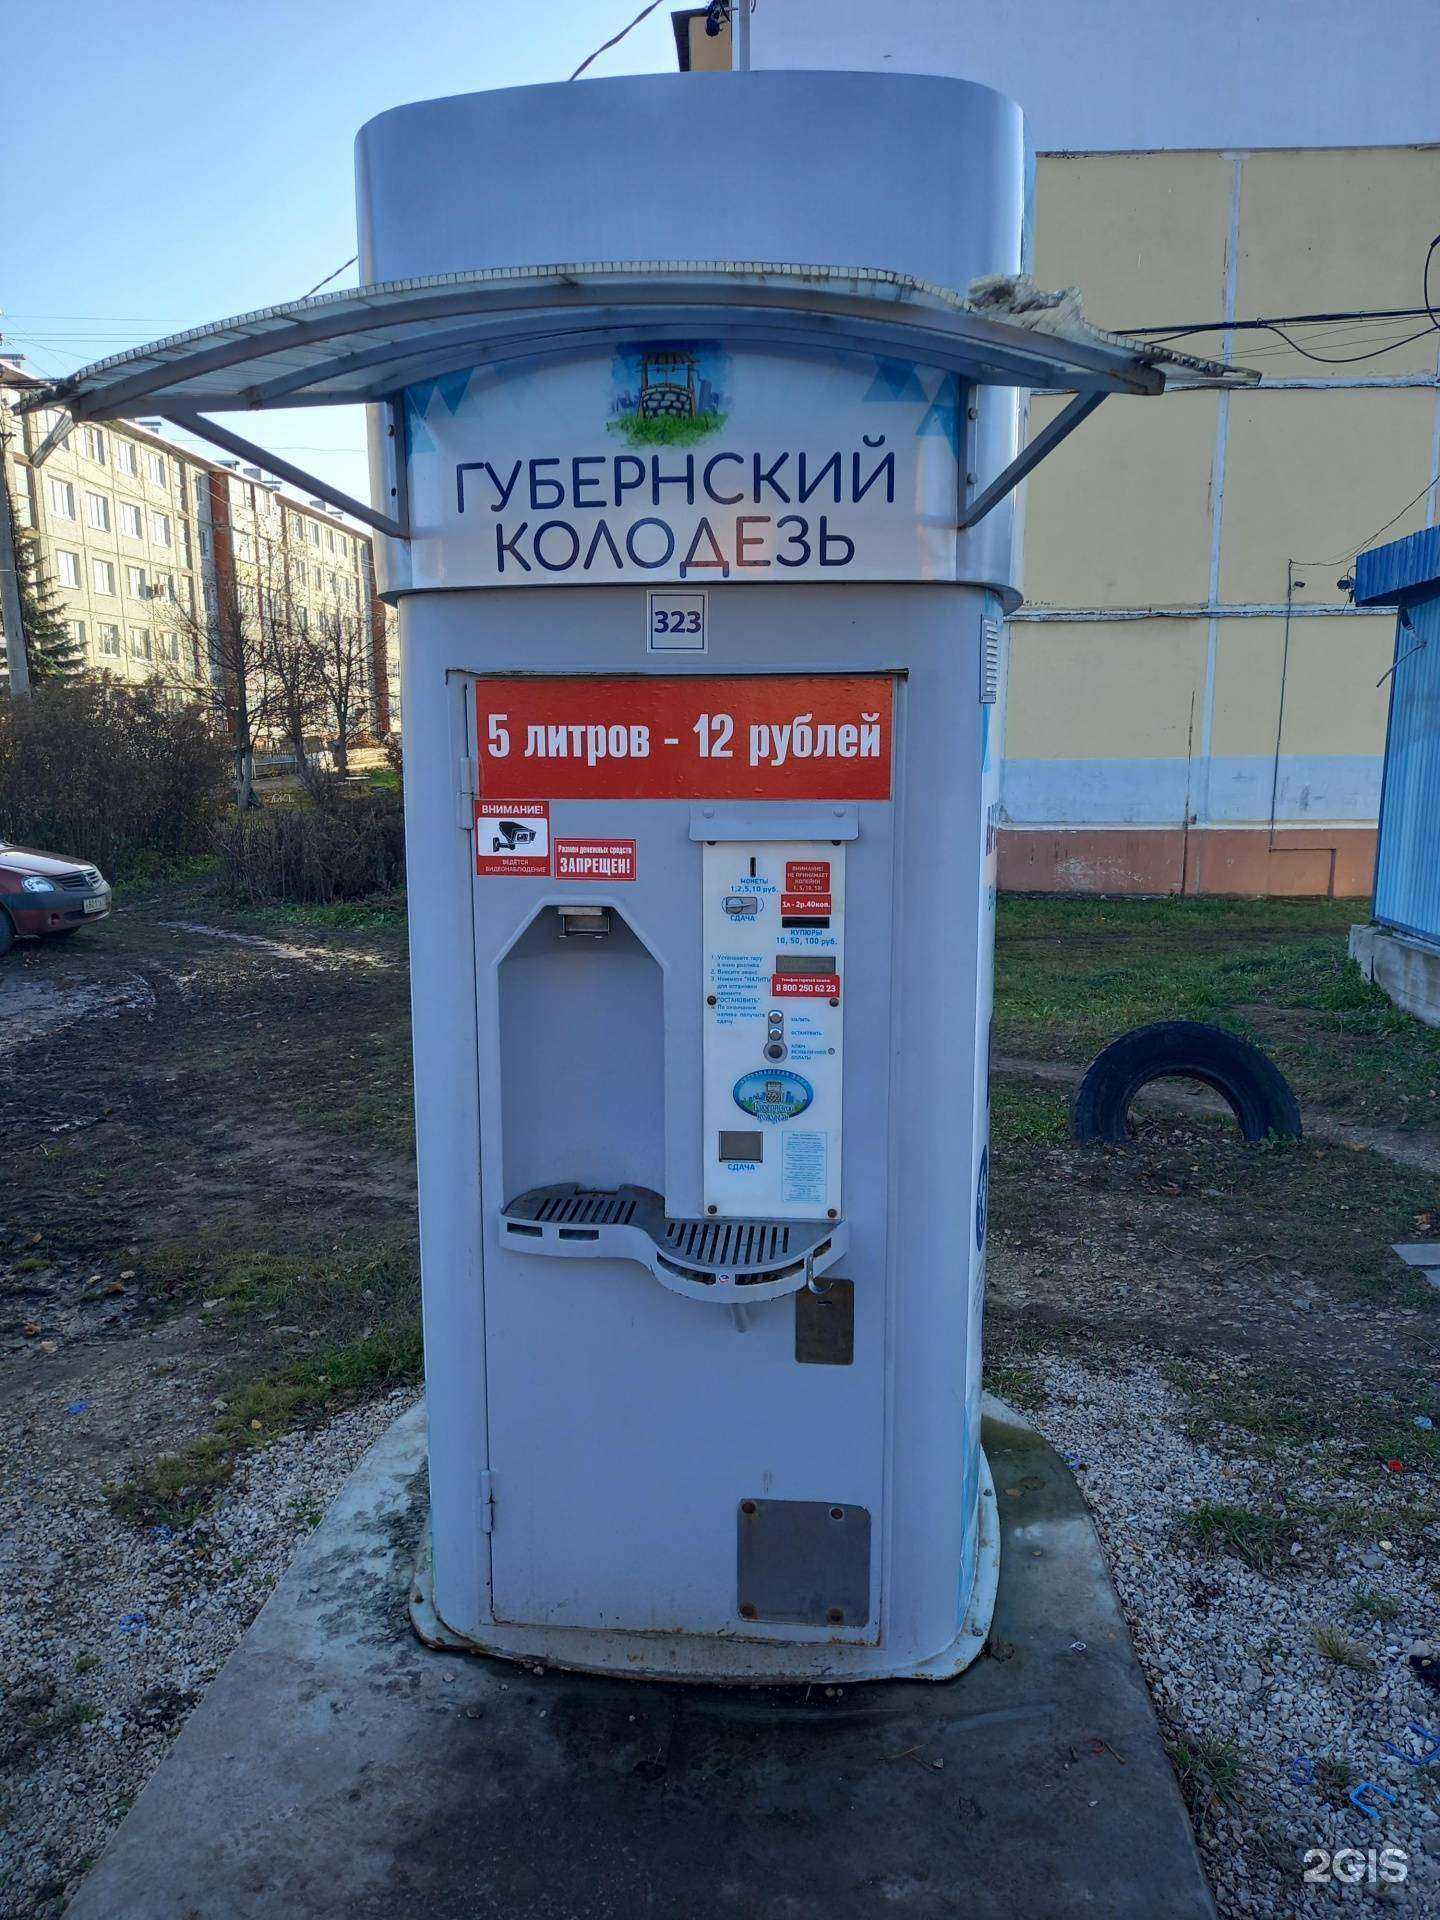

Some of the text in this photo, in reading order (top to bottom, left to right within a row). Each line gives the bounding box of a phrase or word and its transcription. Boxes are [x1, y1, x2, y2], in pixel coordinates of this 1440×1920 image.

[456, 434, 895, 513] ГУБЕРНСКИЙ
[496, 515, 856, 579] КОЛОДЕЗЬ
[654, 610, 702, 634] 323
[487, 713, 509, 757] 5
[524, 719, 650, 767] литров
[693, 713, 734, 758] 12
[749, 712, 881, 767] рублей
[482, 805, 544, 815] ВНИМАНИЕ!
[560, 857, 631, 875] ЗАПРЕЩЕН!
[776, 984, 782, 992] 8
[782, 984, 797, 992] 800
[798, 984, 813, 992] 250
[815, 984, 825, 992] 62
